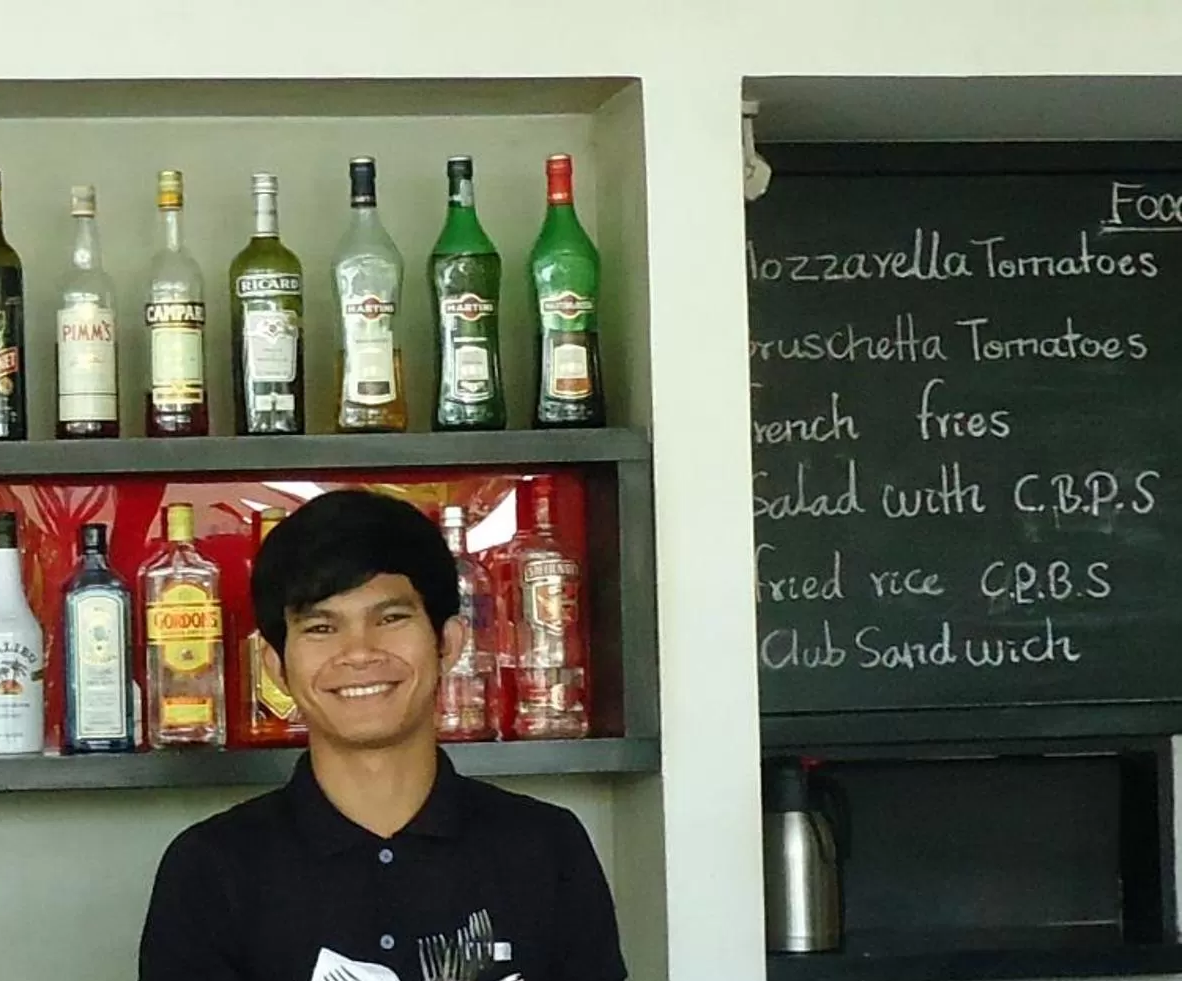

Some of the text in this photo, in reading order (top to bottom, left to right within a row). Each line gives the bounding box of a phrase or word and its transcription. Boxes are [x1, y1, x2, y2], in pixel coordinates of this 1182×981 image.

[1101, 181, 1182, 225] Foo
[748, 228, 1159, 280] ozzarella Tomatoes
[240, 278, 299, 292] RICARD
[62, 320, 112, 342] PIMM'S
[955, 317, 1149, 361] Tomatoes
[751, 378, 1011, 444] rench fries
[753, 459, 866, 519] Salad
[881, 462, 986, 519] with
[870, 569, 946, 598] rice
[761, 620, 847, 669] Club
